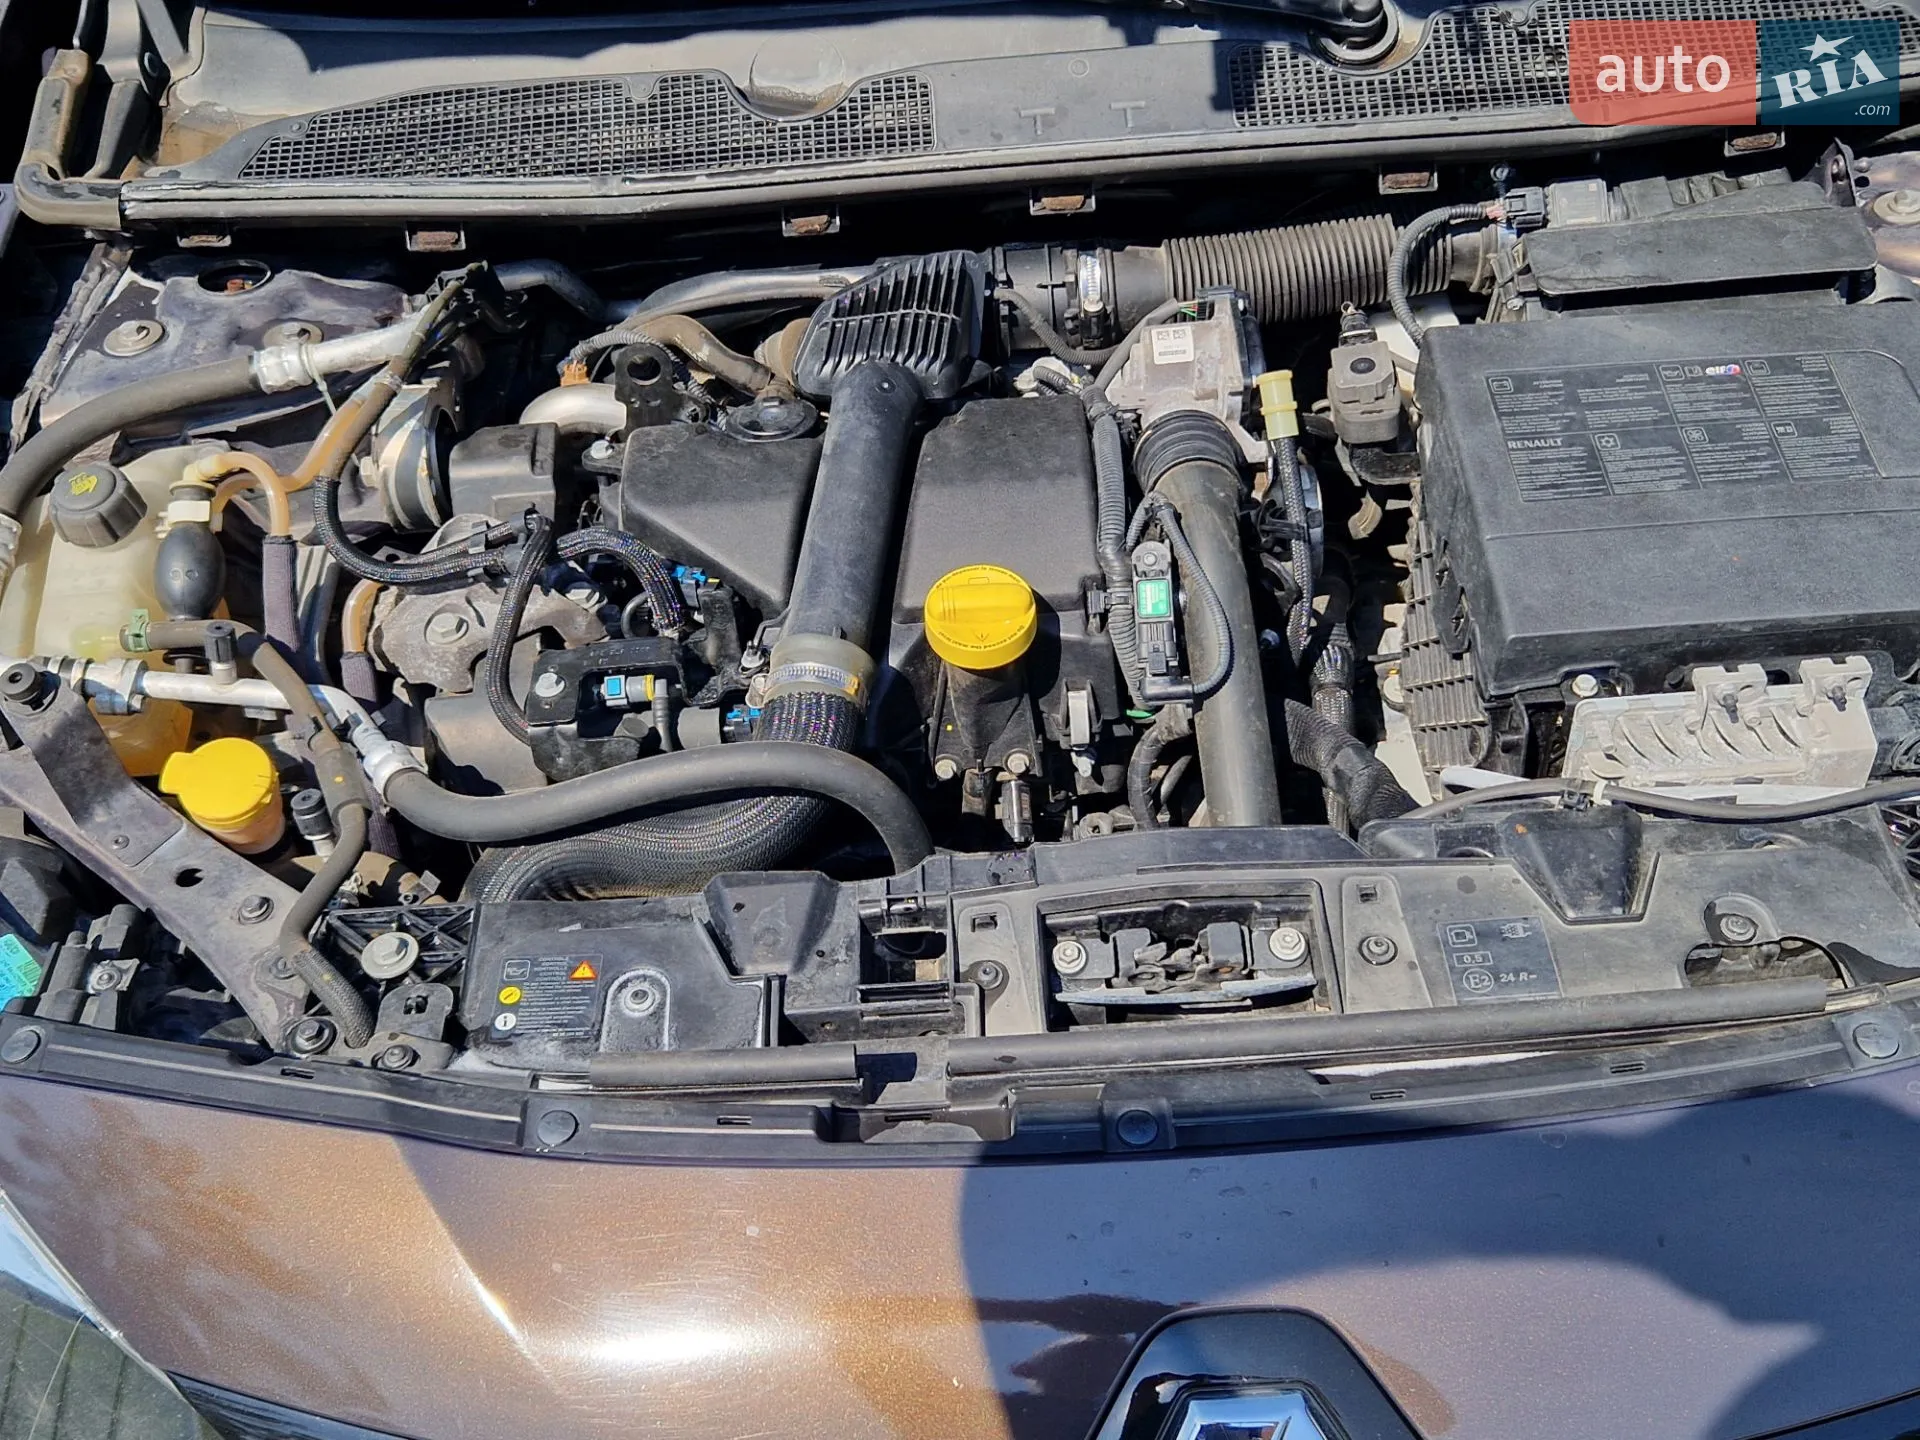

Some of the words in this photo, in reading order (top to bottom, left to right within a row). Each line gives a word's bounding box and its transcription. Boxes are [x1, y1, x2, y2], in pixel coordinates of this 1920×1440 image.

[1507, 438, 1563, 449] RENAULT
[1463, 955, 1483, 964] 0,5
[1468, 974, 1491, 989] E2
[1500, 972, 1516, 983] 24
